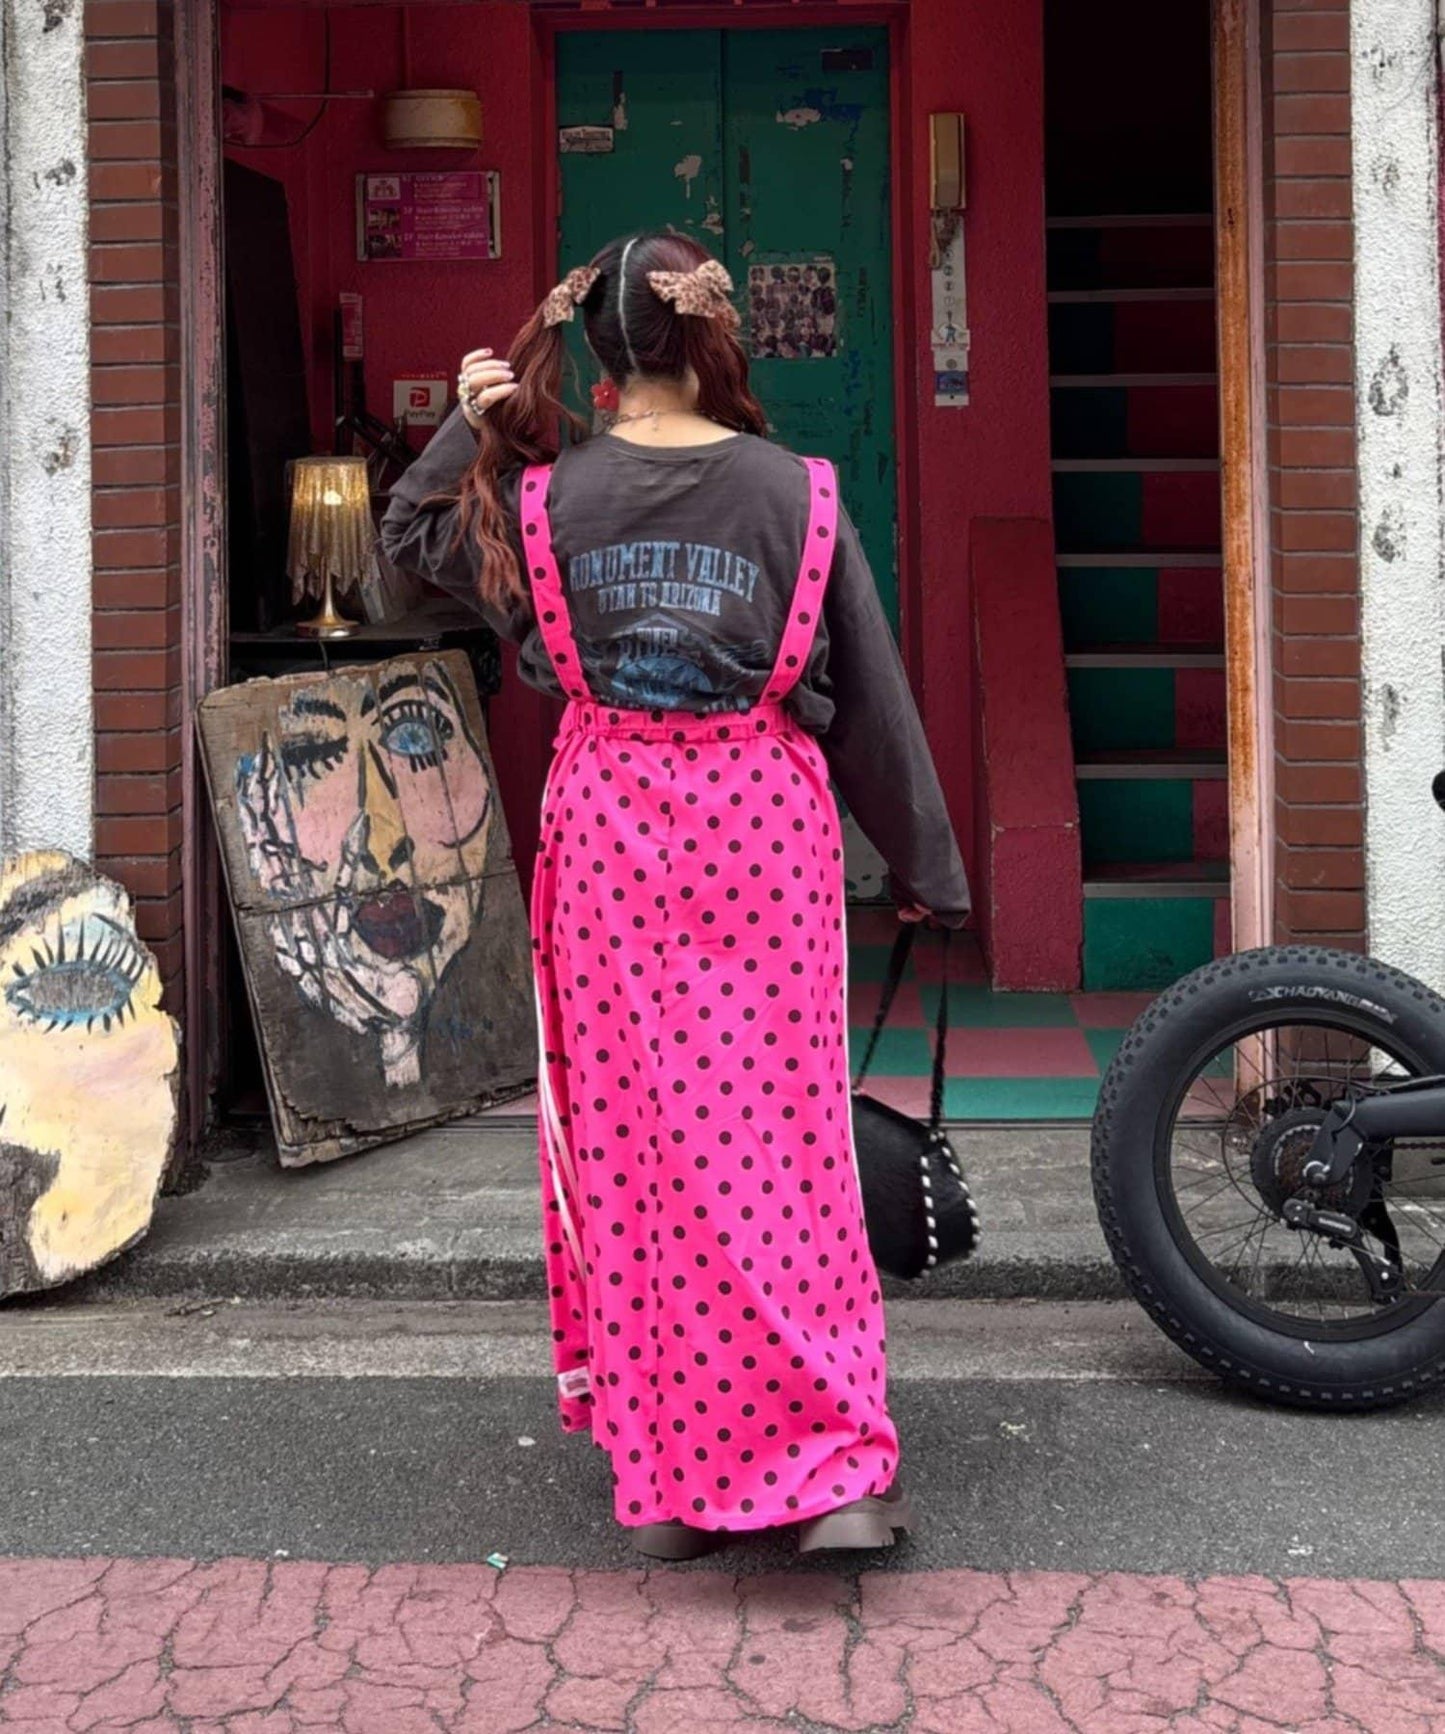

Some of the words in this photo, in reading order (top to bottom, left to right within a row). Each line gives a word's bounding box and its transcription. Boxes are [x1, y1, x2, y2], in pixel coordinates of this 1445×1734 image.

[685, 542, 760, 603] VALLEY
[597, 583, 637, 615] UTAH
[660, 581, 723, 617] ARIZONA
